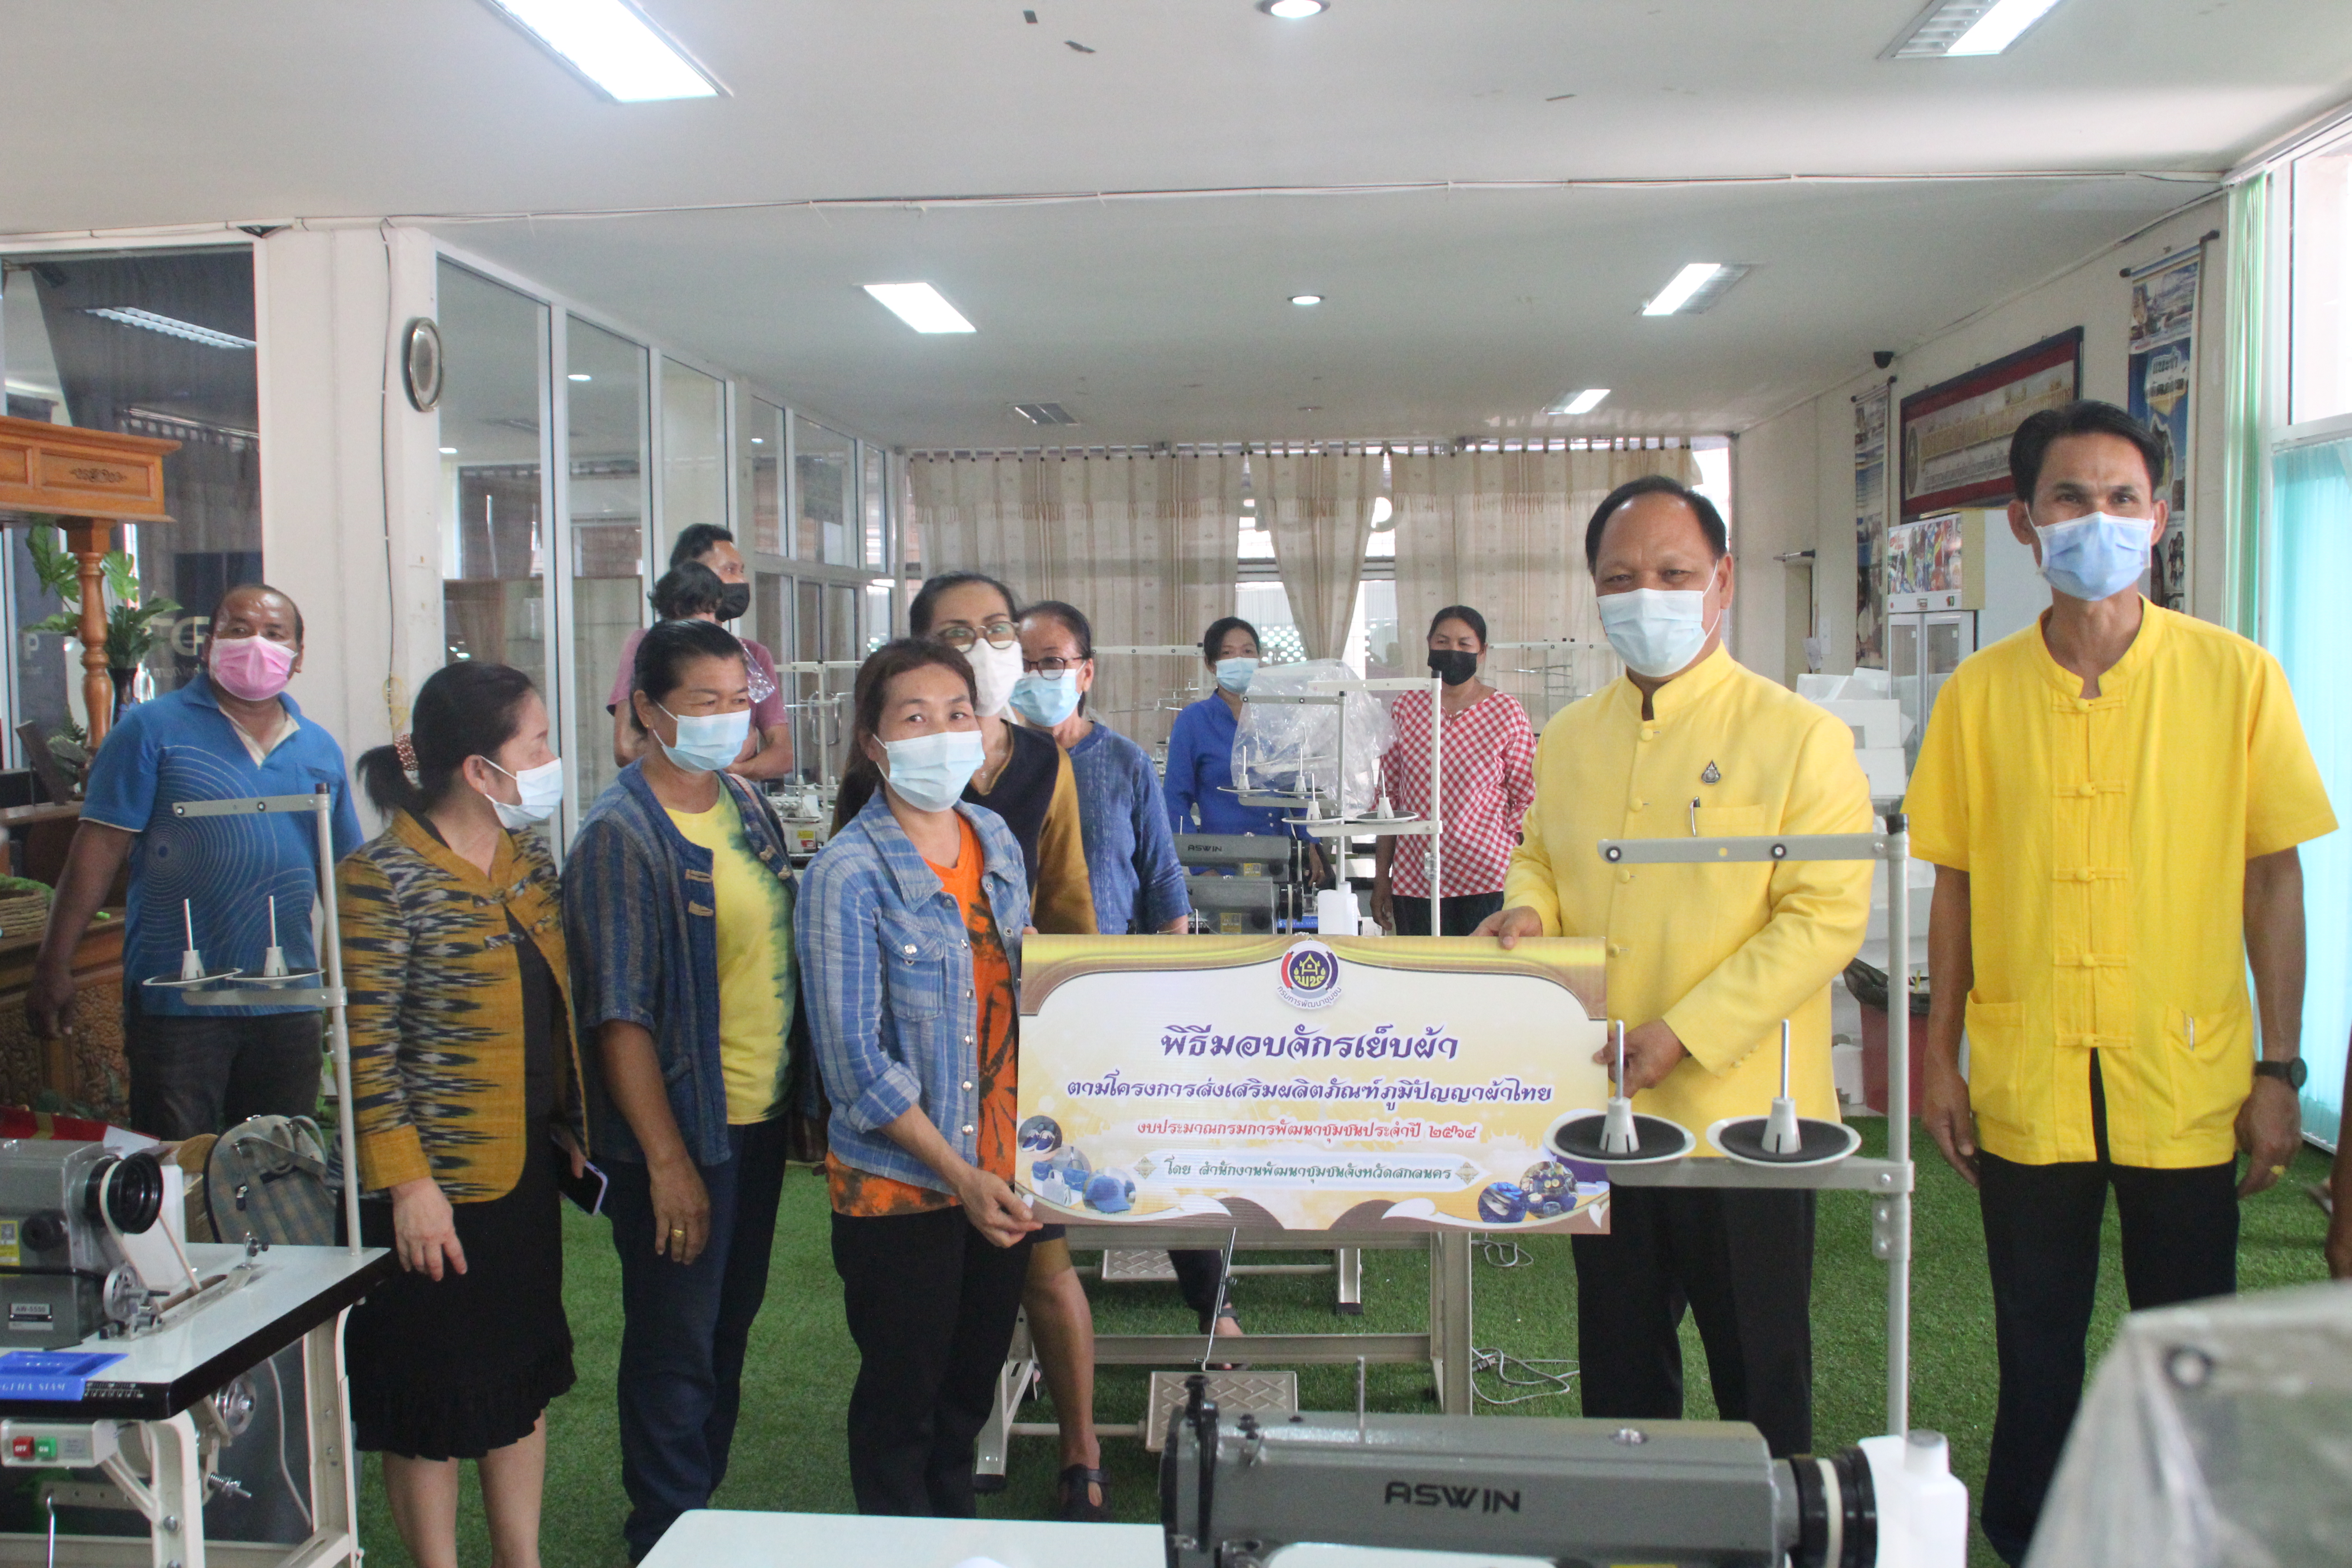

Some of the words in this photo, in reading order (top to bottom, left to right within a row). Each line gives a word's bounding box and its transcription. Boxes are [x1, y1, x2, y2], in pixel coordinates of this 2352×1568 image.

[1277, 986, 1342, 1008] กรมการพัฒนาชุมชน
[1161, 1024, 1458, 1059] พิธีมอบจักรเย็บผ้า
[1068, 1069, 1551, 1111] ตามโครงการส่งเสริมผลิตภัณฑ์ภูมิปัญญาผ้าไทย
[1137, 1119, 1421, 1143] งบประมาณกรมการพัฒนาชุมชนประจำปี
[1429, 1125, 1476, 1138] ๒๕๖๔
[1164, 1156, 1191, 1175] โดย
[1199, 1161, 1451, 1184] สำนักงานพัฒนาชุมชนจังหวัดสกลนคร
[1385, 1481, 1520, 1513] ASWIN
